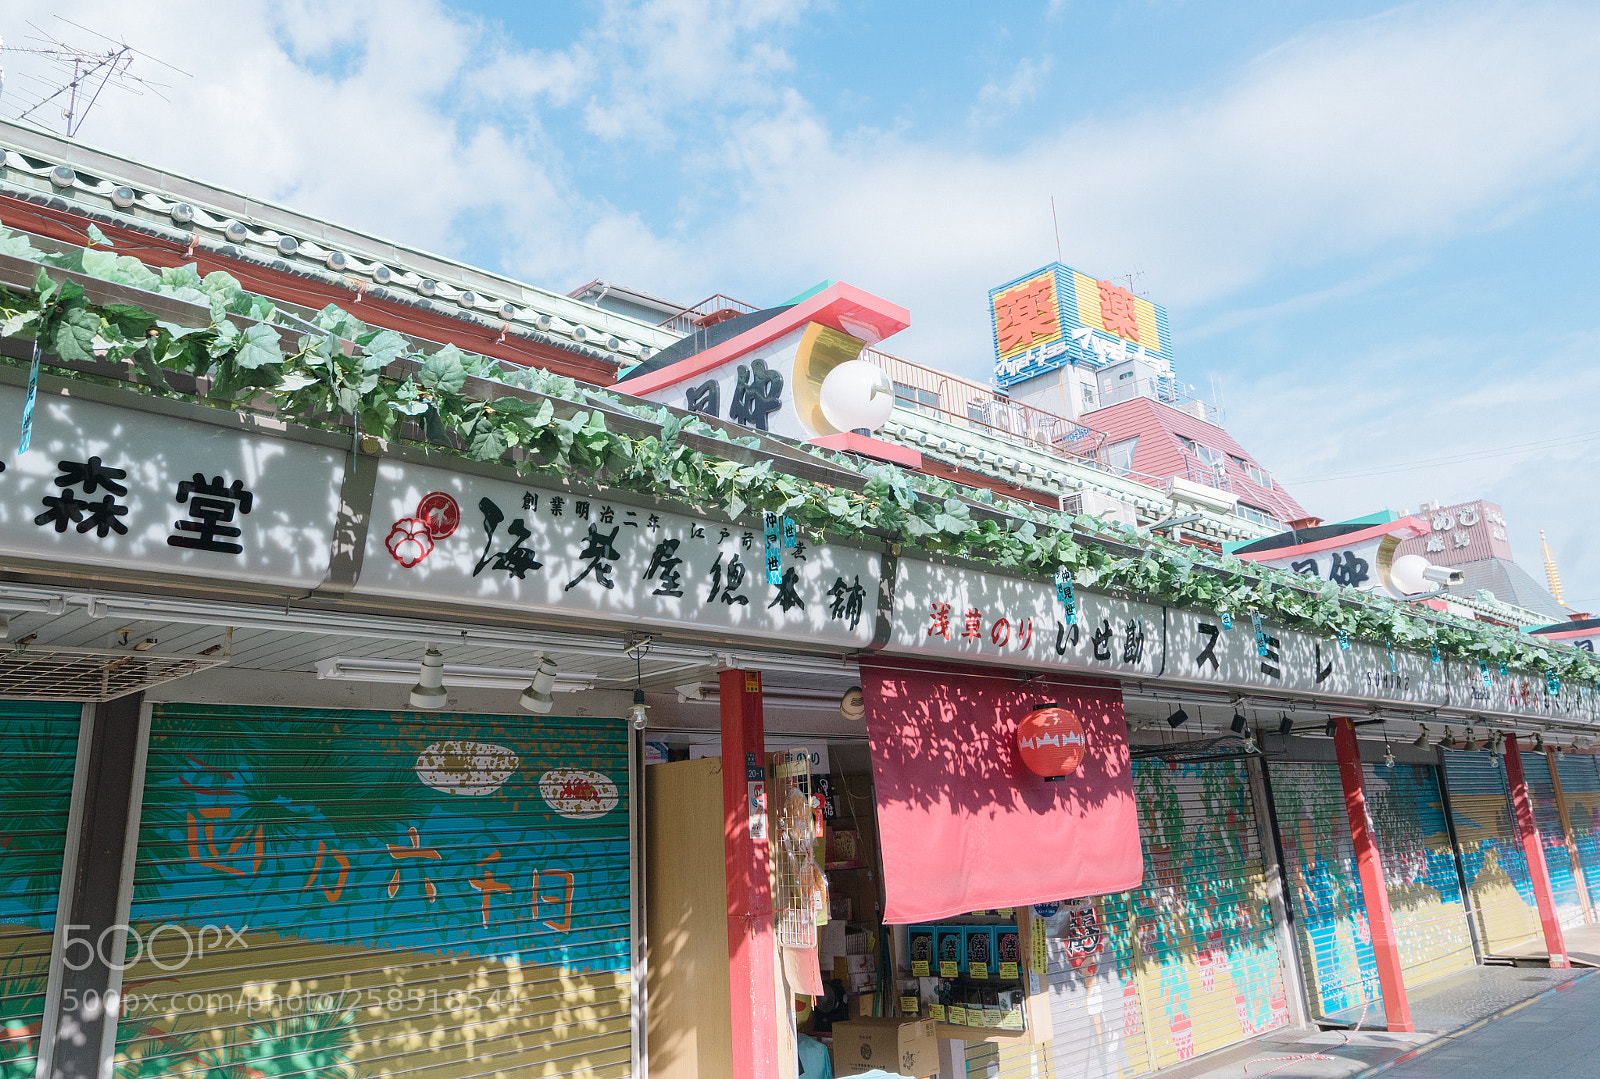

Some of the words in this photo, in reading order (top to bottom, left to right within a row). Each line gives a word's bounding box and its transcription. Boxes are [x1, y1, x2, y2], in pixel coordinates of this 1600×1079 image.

[994, 278, 1058, 352] 薬
[1096, 279, 1141, 343] 薬
[522, 491, 660, 532] 創業明治二年
[1061, 570, 1076, 616] 仲見世
[928, 602, 1032, 651] 浅草のり
[1056, 617, 1144, 665] いせ勘
[1197, 623, 1333, 684] スミレ
[748, 769, 763, 778] 20-1
